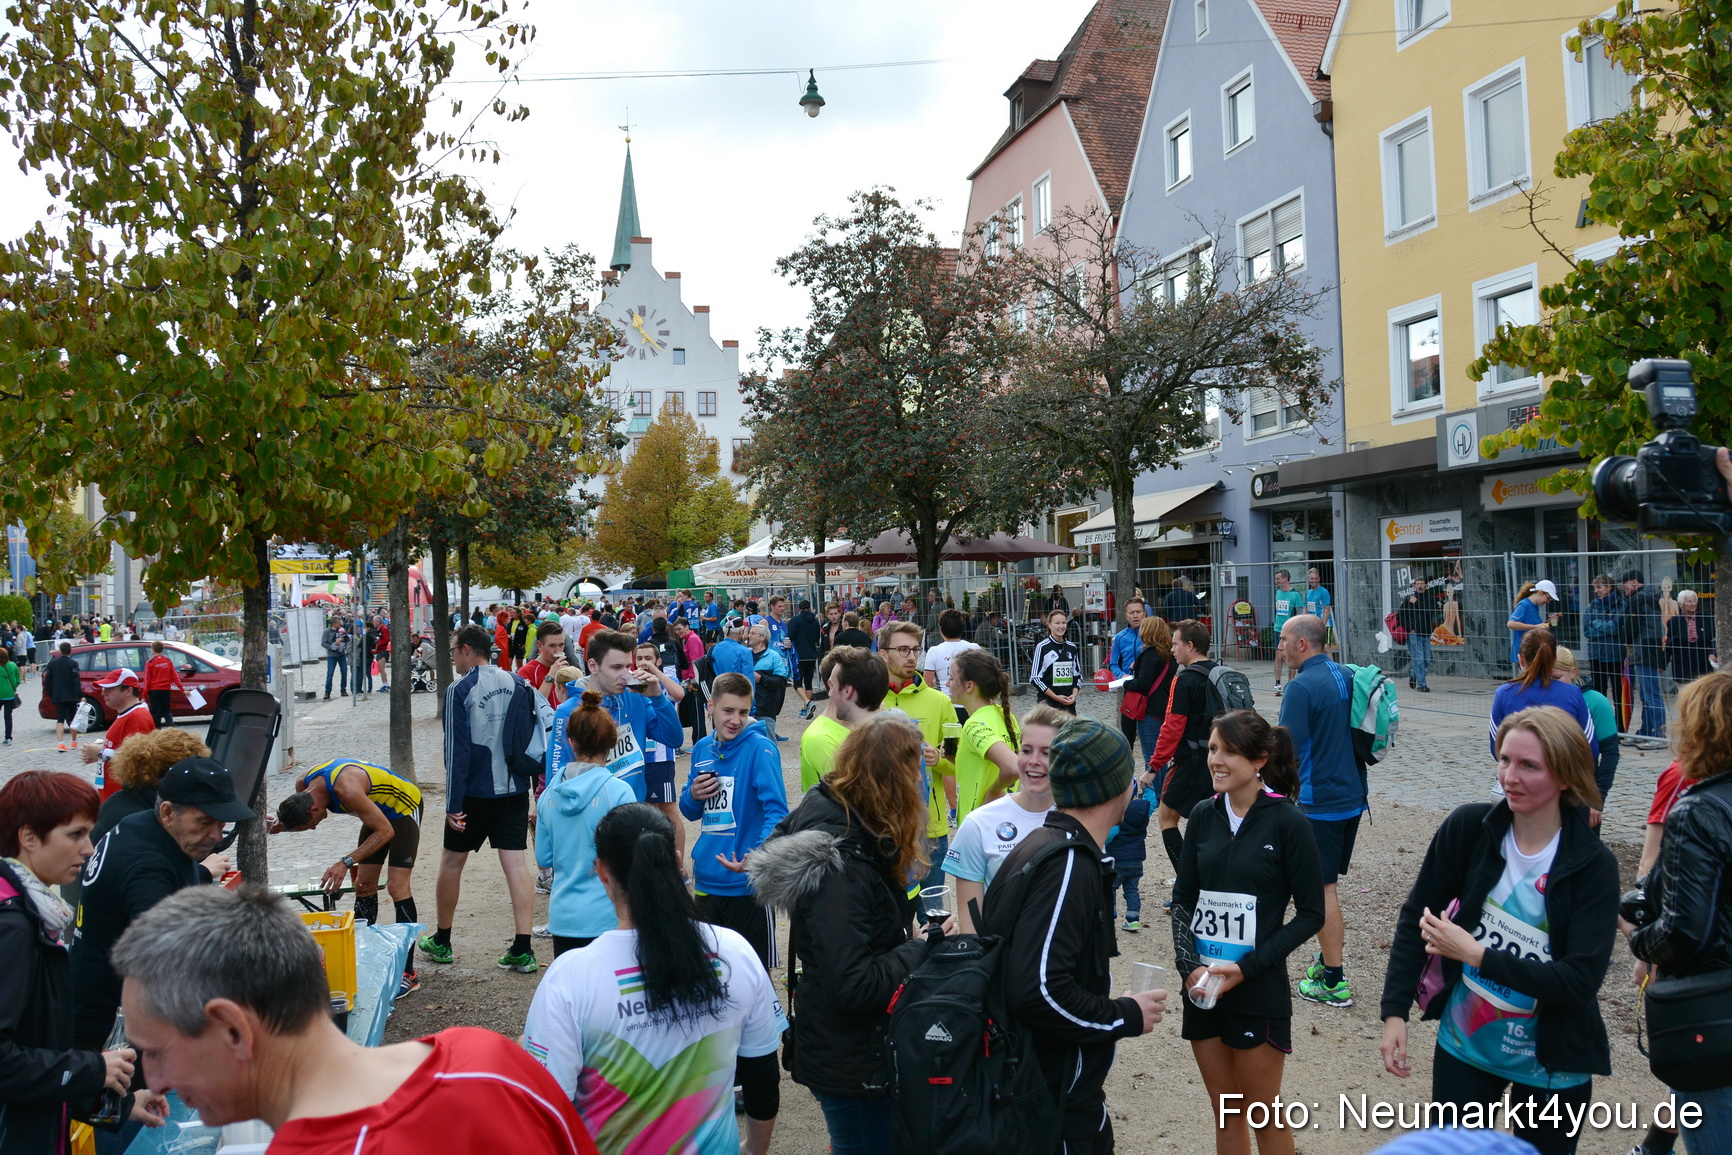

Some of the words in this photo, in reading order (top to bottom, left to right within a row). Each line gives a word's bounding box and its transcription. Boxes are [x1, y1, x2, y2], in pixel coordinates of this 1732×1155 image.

[1500, 479, 1538, 499] Central
[1393, 521, 1423, 538] Central
[1429, 517, 1451, 526] Dauerhafte
[1429, 525, 1460, 534] Haarentfernung
[1084, 534, 1093, 544] EIS
[1094, 531, 1116, 543] FRÜHST
[1396, 566, 1415, 588] IPL
[685, 607, 699, 619] 14
[553, 718, 564, 743] BMW
[606, 734, 634, 764] 108
[611, 759, 630, 772] Tobias
[704, 789, 728, 811] 023
[1208, 899, 1243, 909] Neumarkt
[1194, 908, 1245, 941] 2311
[1481, 909, 1496, 925] RTL
[1497, 919, 1540, 949] Neumarkt
[1209, 944, 1223, 957] Evi
[626, 1018, 665, 1032] einkaufen
[1506, 1021, 1529, 1039] 16.
